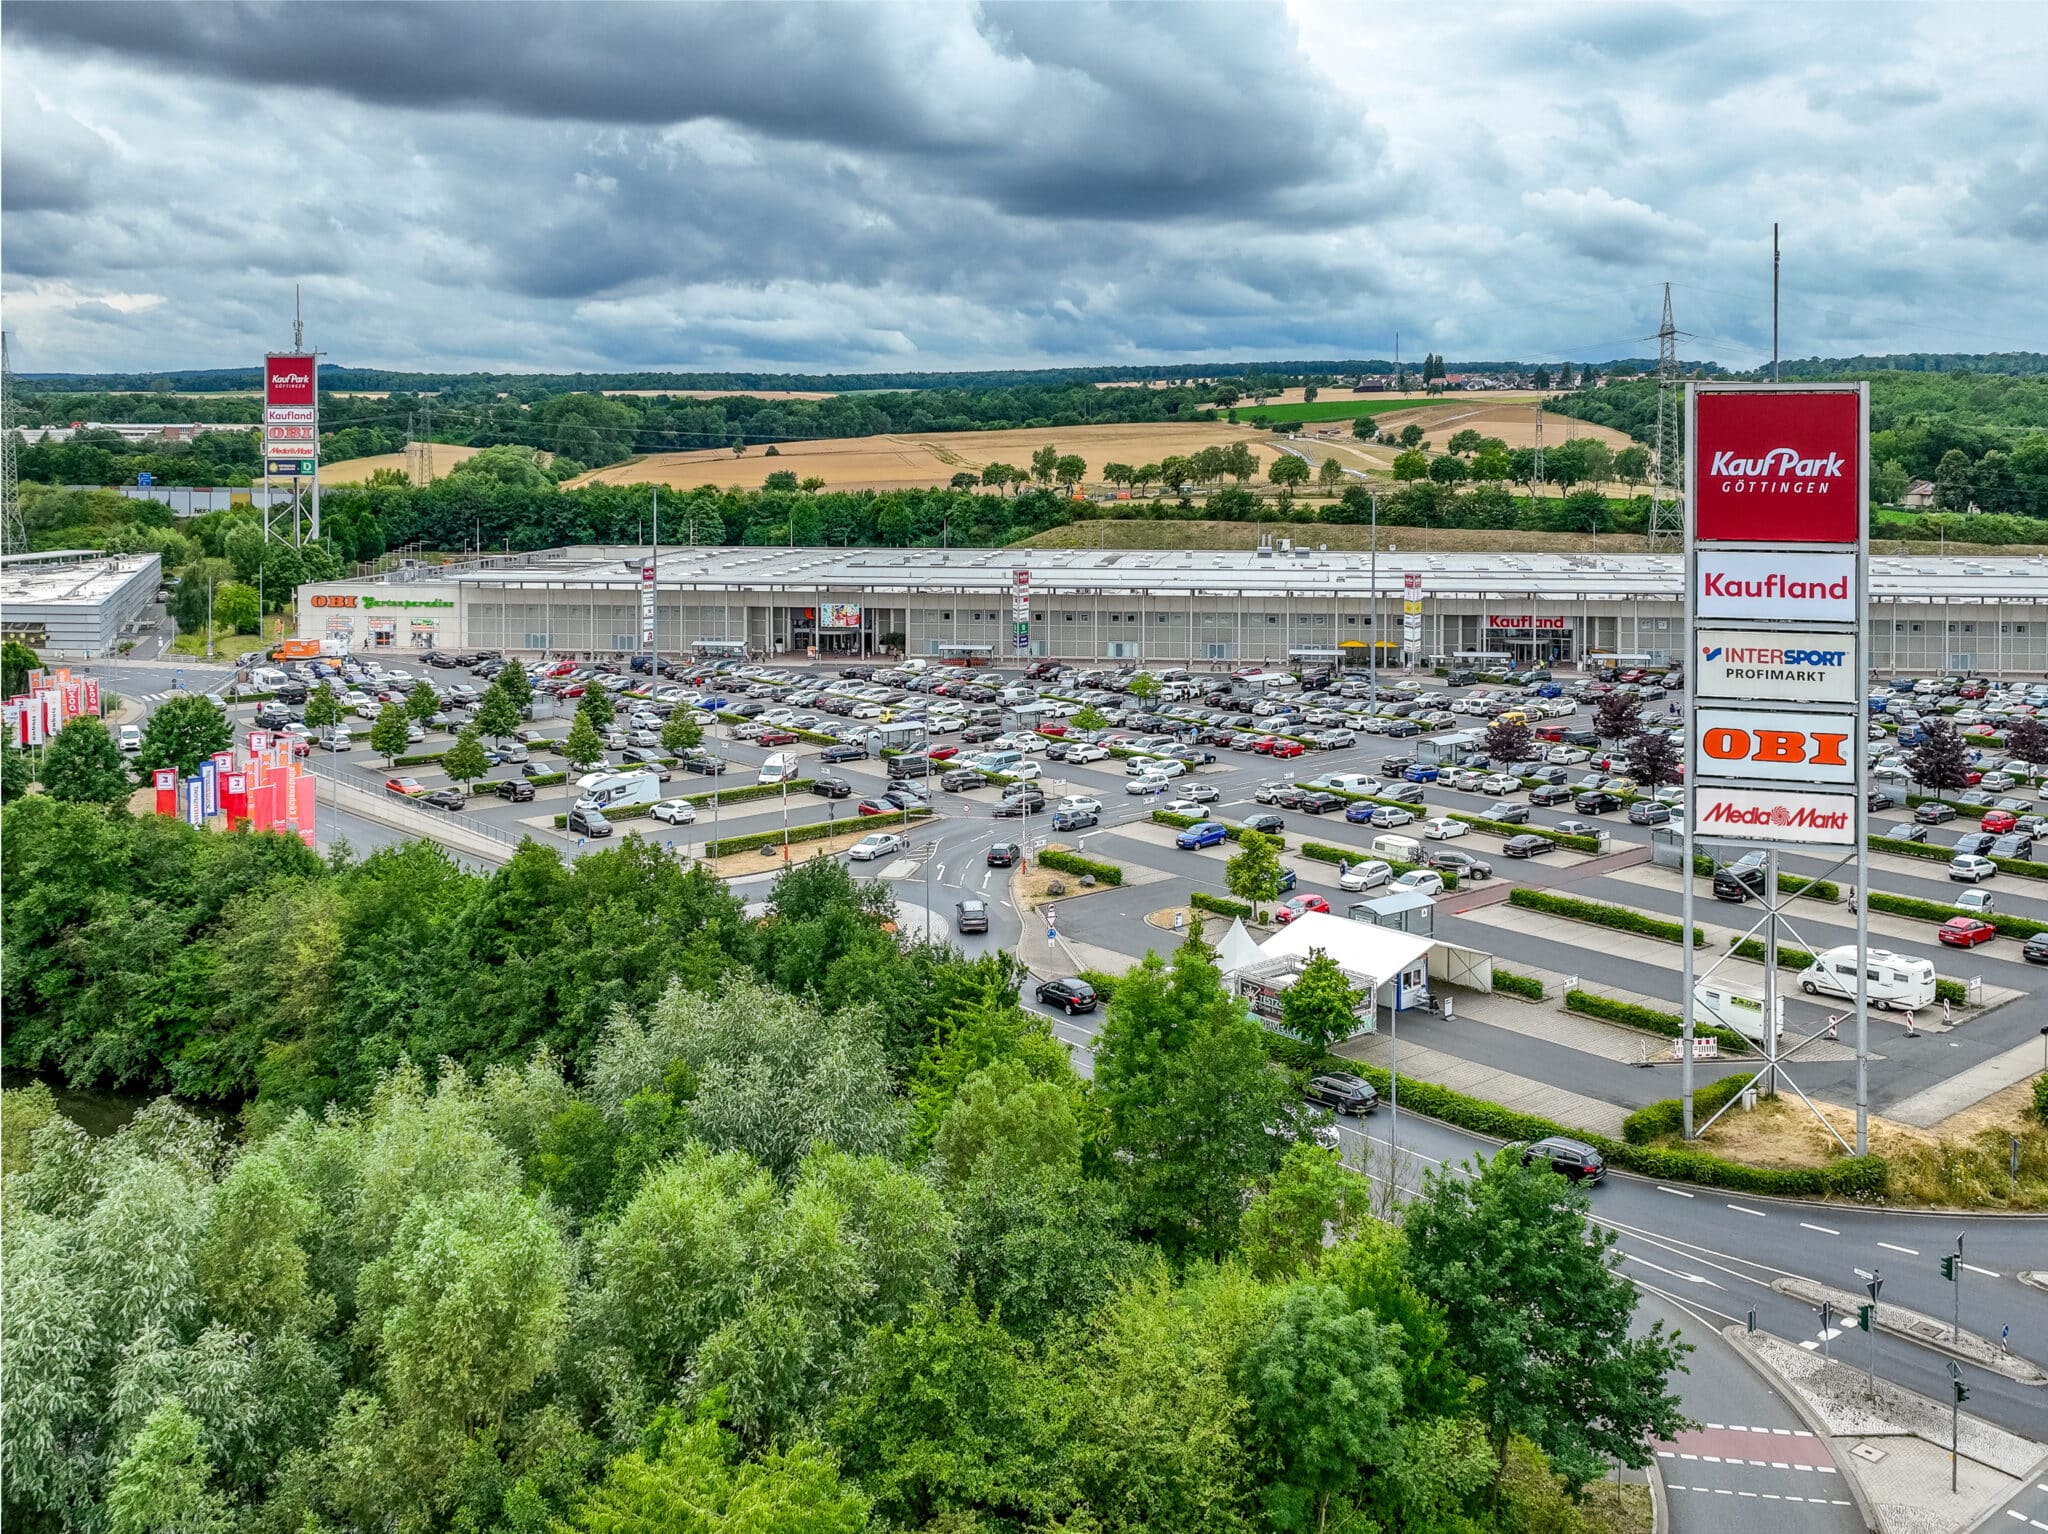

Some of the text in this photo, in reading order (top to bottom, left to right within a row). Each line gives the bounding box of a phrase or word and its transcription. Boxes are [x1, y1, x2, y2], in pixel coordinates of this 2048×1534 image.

[269, 411, 312, 420] Kaufland
[269, 427, 312, 438] OBI
[1722, 480, 1829, 493] GÖTTINGEN
[1705, 573, 1848, 599] Kaufland
[311, 595, 358, 608] OBI
[1489, 615, 1564, 628] Kaufland
[1725, 647, 1846, 666] INTERSPORT
[1726, 668, 1826, 682] PROFIMARKT
[1703, 727, 1848, 766] OBI
[1703, 802, 1848, 830] Media Markt
